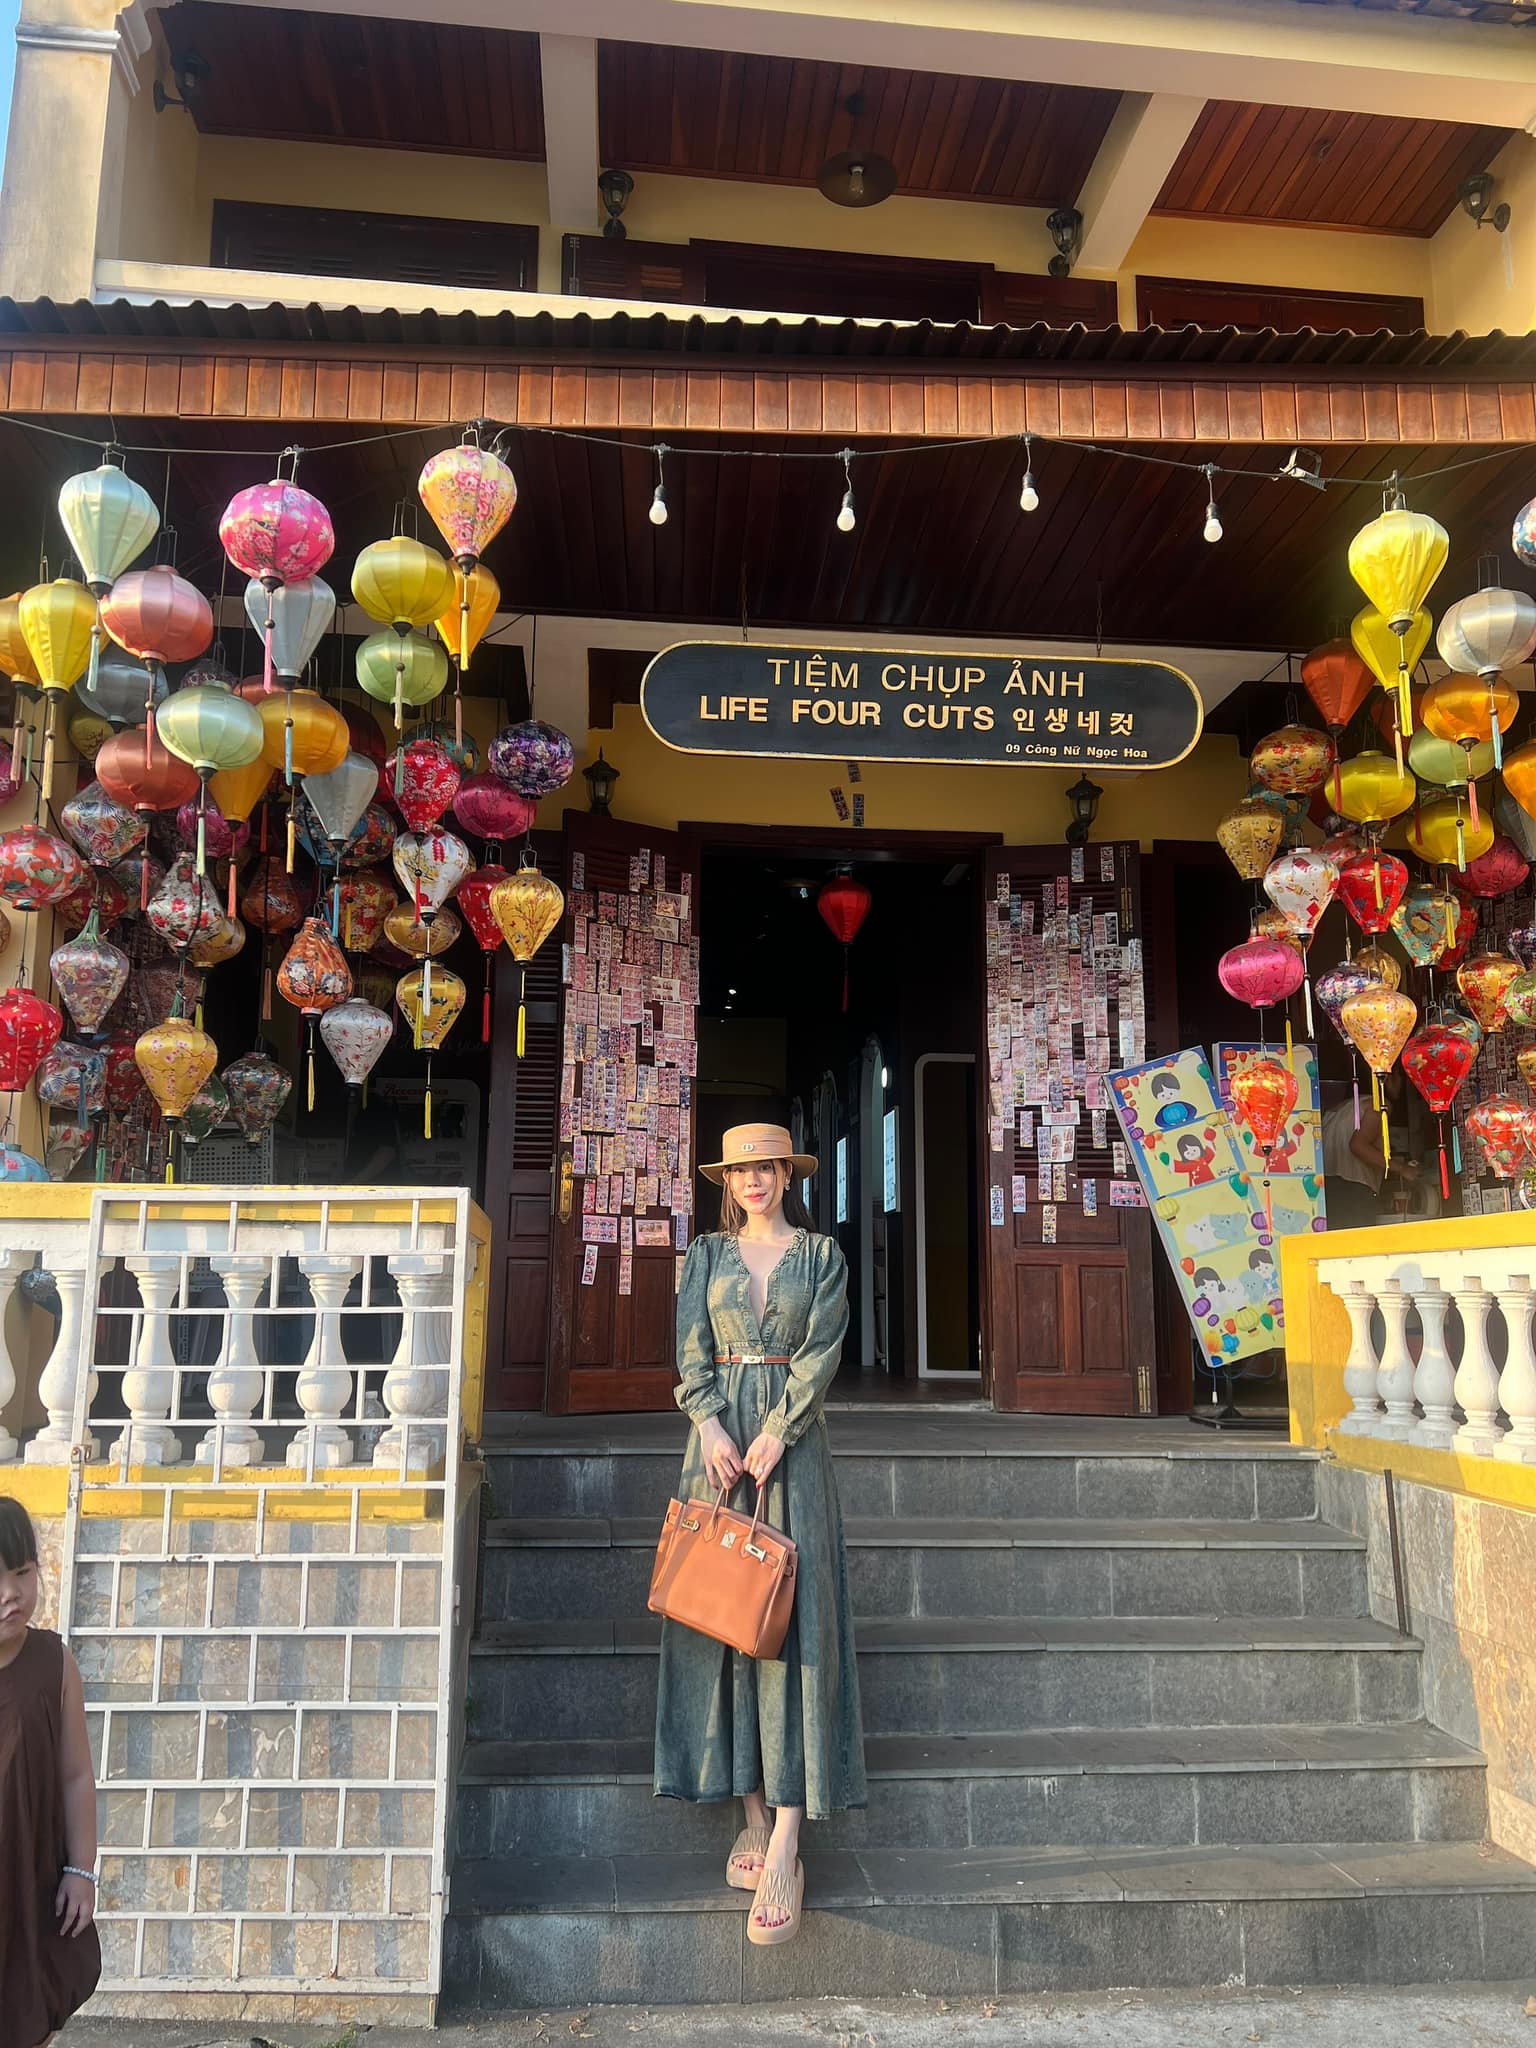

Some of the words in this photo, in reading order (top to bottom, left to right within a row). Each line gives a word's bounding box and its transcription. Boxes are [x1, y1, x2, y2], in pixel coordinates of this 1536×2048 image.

[766, 654, 859, 693] TIỆM
[881, 664, 986, 699] CHỤP
[1003, 658, 1086, 698] ẢNH
[700, 695, 769, 722] LIFE
[792, 699, 881, 726] FOUR
[903, 703, 995, 731] CUTS
[1005, 743, 1021, 754] 09
[1024, 743, 1057, 757] Công
[1086, 746, 1118, 759] Ngọc
[1123, 747, 1148, 759] Hoa
